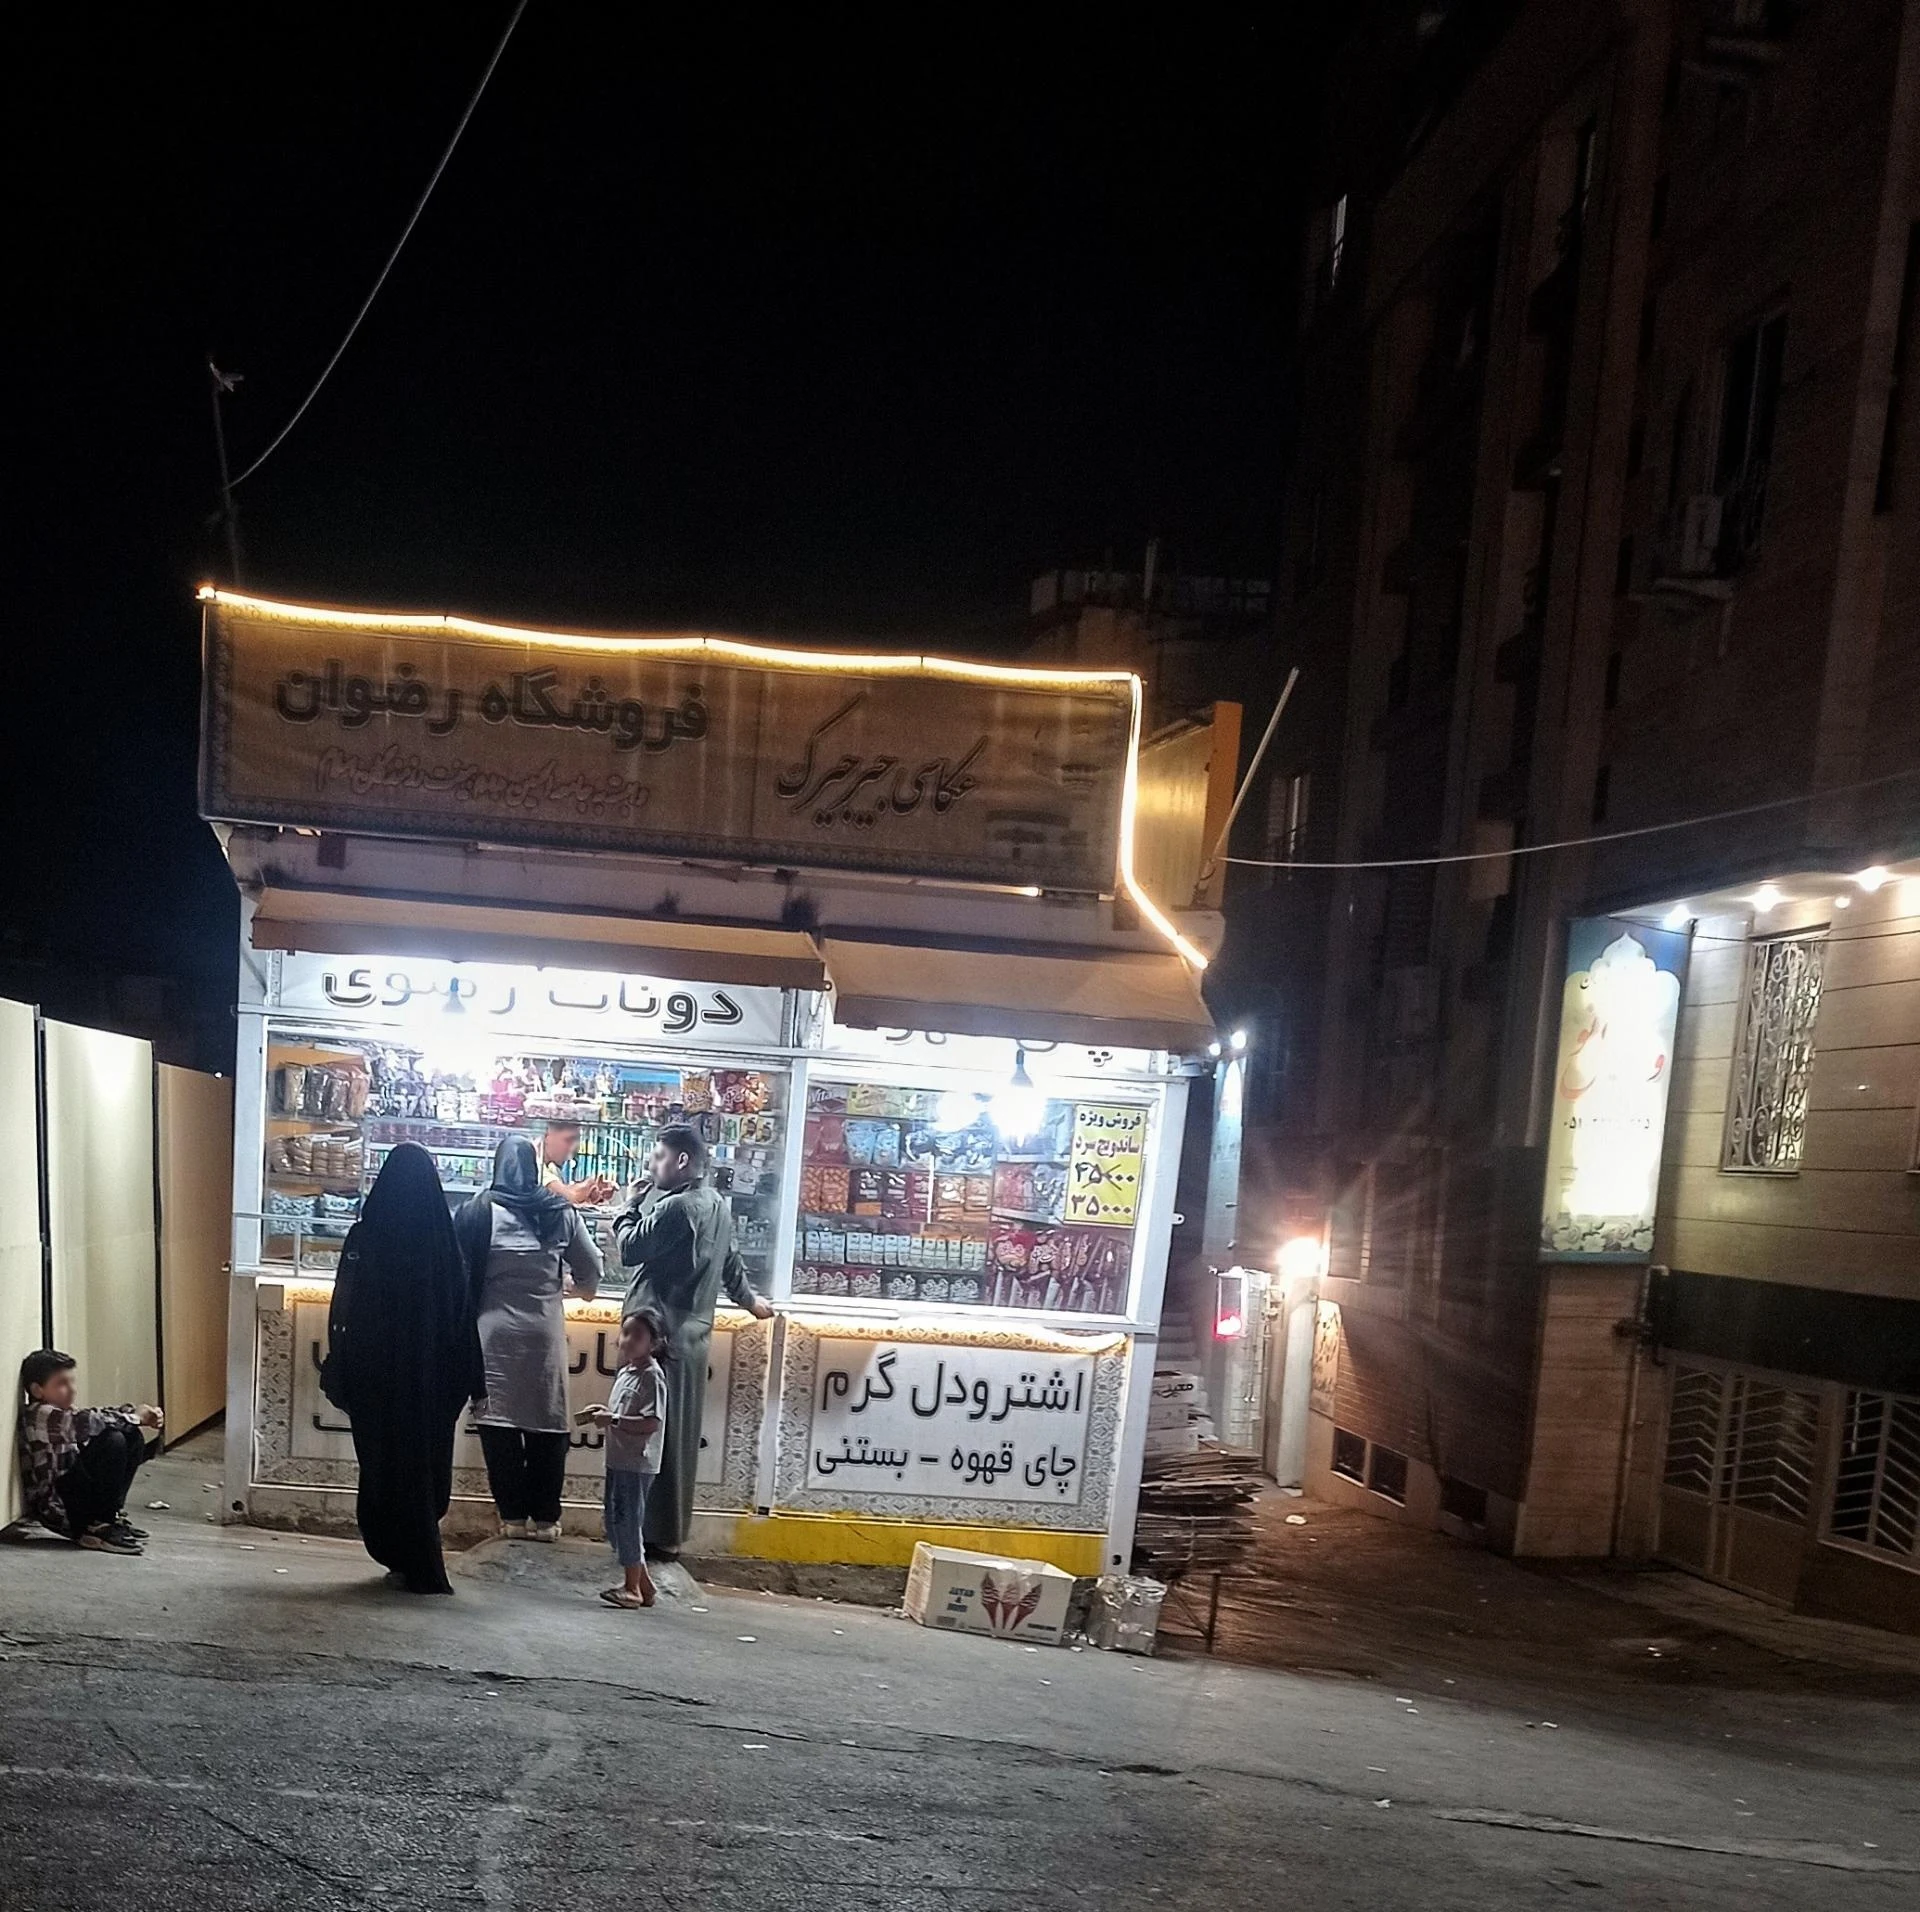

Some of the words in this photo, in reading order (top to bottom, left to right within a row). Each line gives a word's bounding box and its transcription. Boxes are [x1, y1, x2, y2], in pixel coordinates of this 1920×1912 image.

[273, 657, 461, 736] رضوان
[480, 664, 710, 753] فروشگاه
[891, 735, 988, 815] عکاسی
[549, 979, 743, 1034] دونات
[1080, 1110, 1104, 1127] ویژه
[1106, 1112, 1141, 1129] فروش
[1075, 1136, 1095, 1155] سرد
[1097, 1135, 1139, 1157] ساندویچ
[1071, 1194, 1131, 1215] ۳۵۰۰۰
[822, 1351, 896, 1412] گرم
[910, 1361, 1083, 1421] اشترودل
[816, 1438, 908, 1479] بستنی
[951, 1442, 1013, 1484] قهوه
[1025, 1446, 1076, 1494] چای
